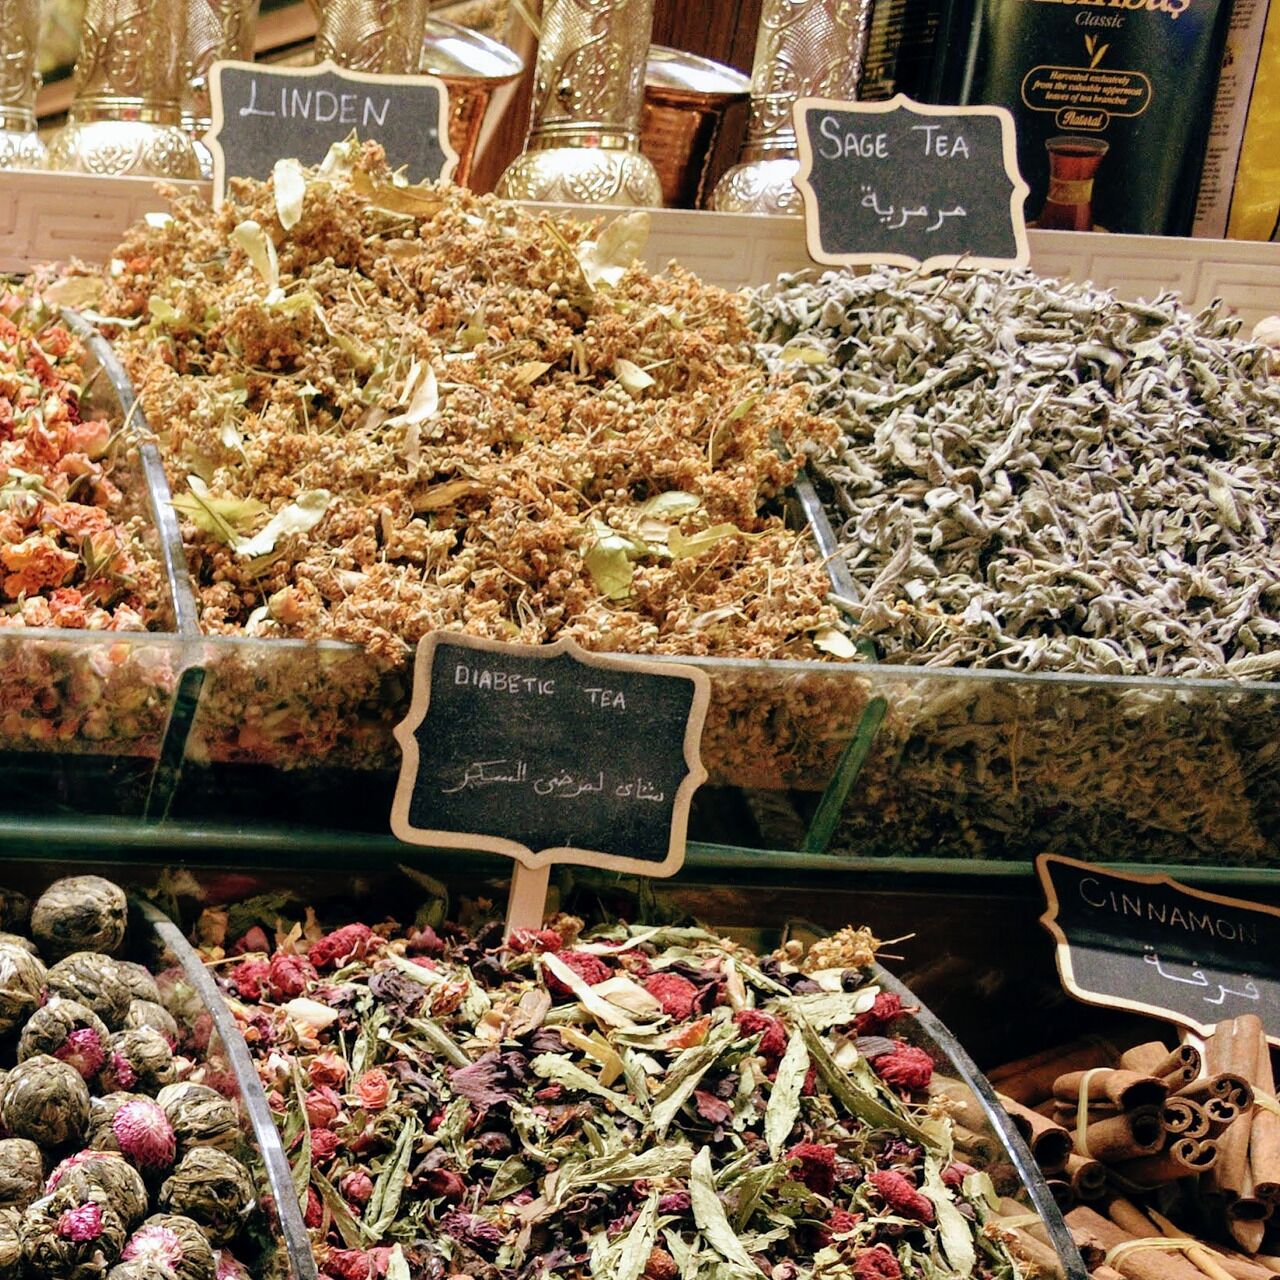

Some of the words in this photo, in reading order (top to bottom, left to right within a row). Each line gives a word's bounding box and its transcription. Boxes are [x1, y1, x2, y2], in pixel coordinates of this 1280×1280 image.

[1074, 11, 1125, 28] Classic
[1049, 71, 1089, 82] Harvested
[1089, 75, 1131, 86] exclusively
[241, 79, 389, 127] LINDEN
[1062, 111, 1103, 127] Natural
[820, 117, 889, 159] SAGE
[912, 124, 969, 158] TEA
[861, 185, 967, 233] مرمرية
[454, 665, 555, 695] DIABETIC
[584, 687, 626, 711] TEA
[1079, 876, 1258, 945] CINNAMON
